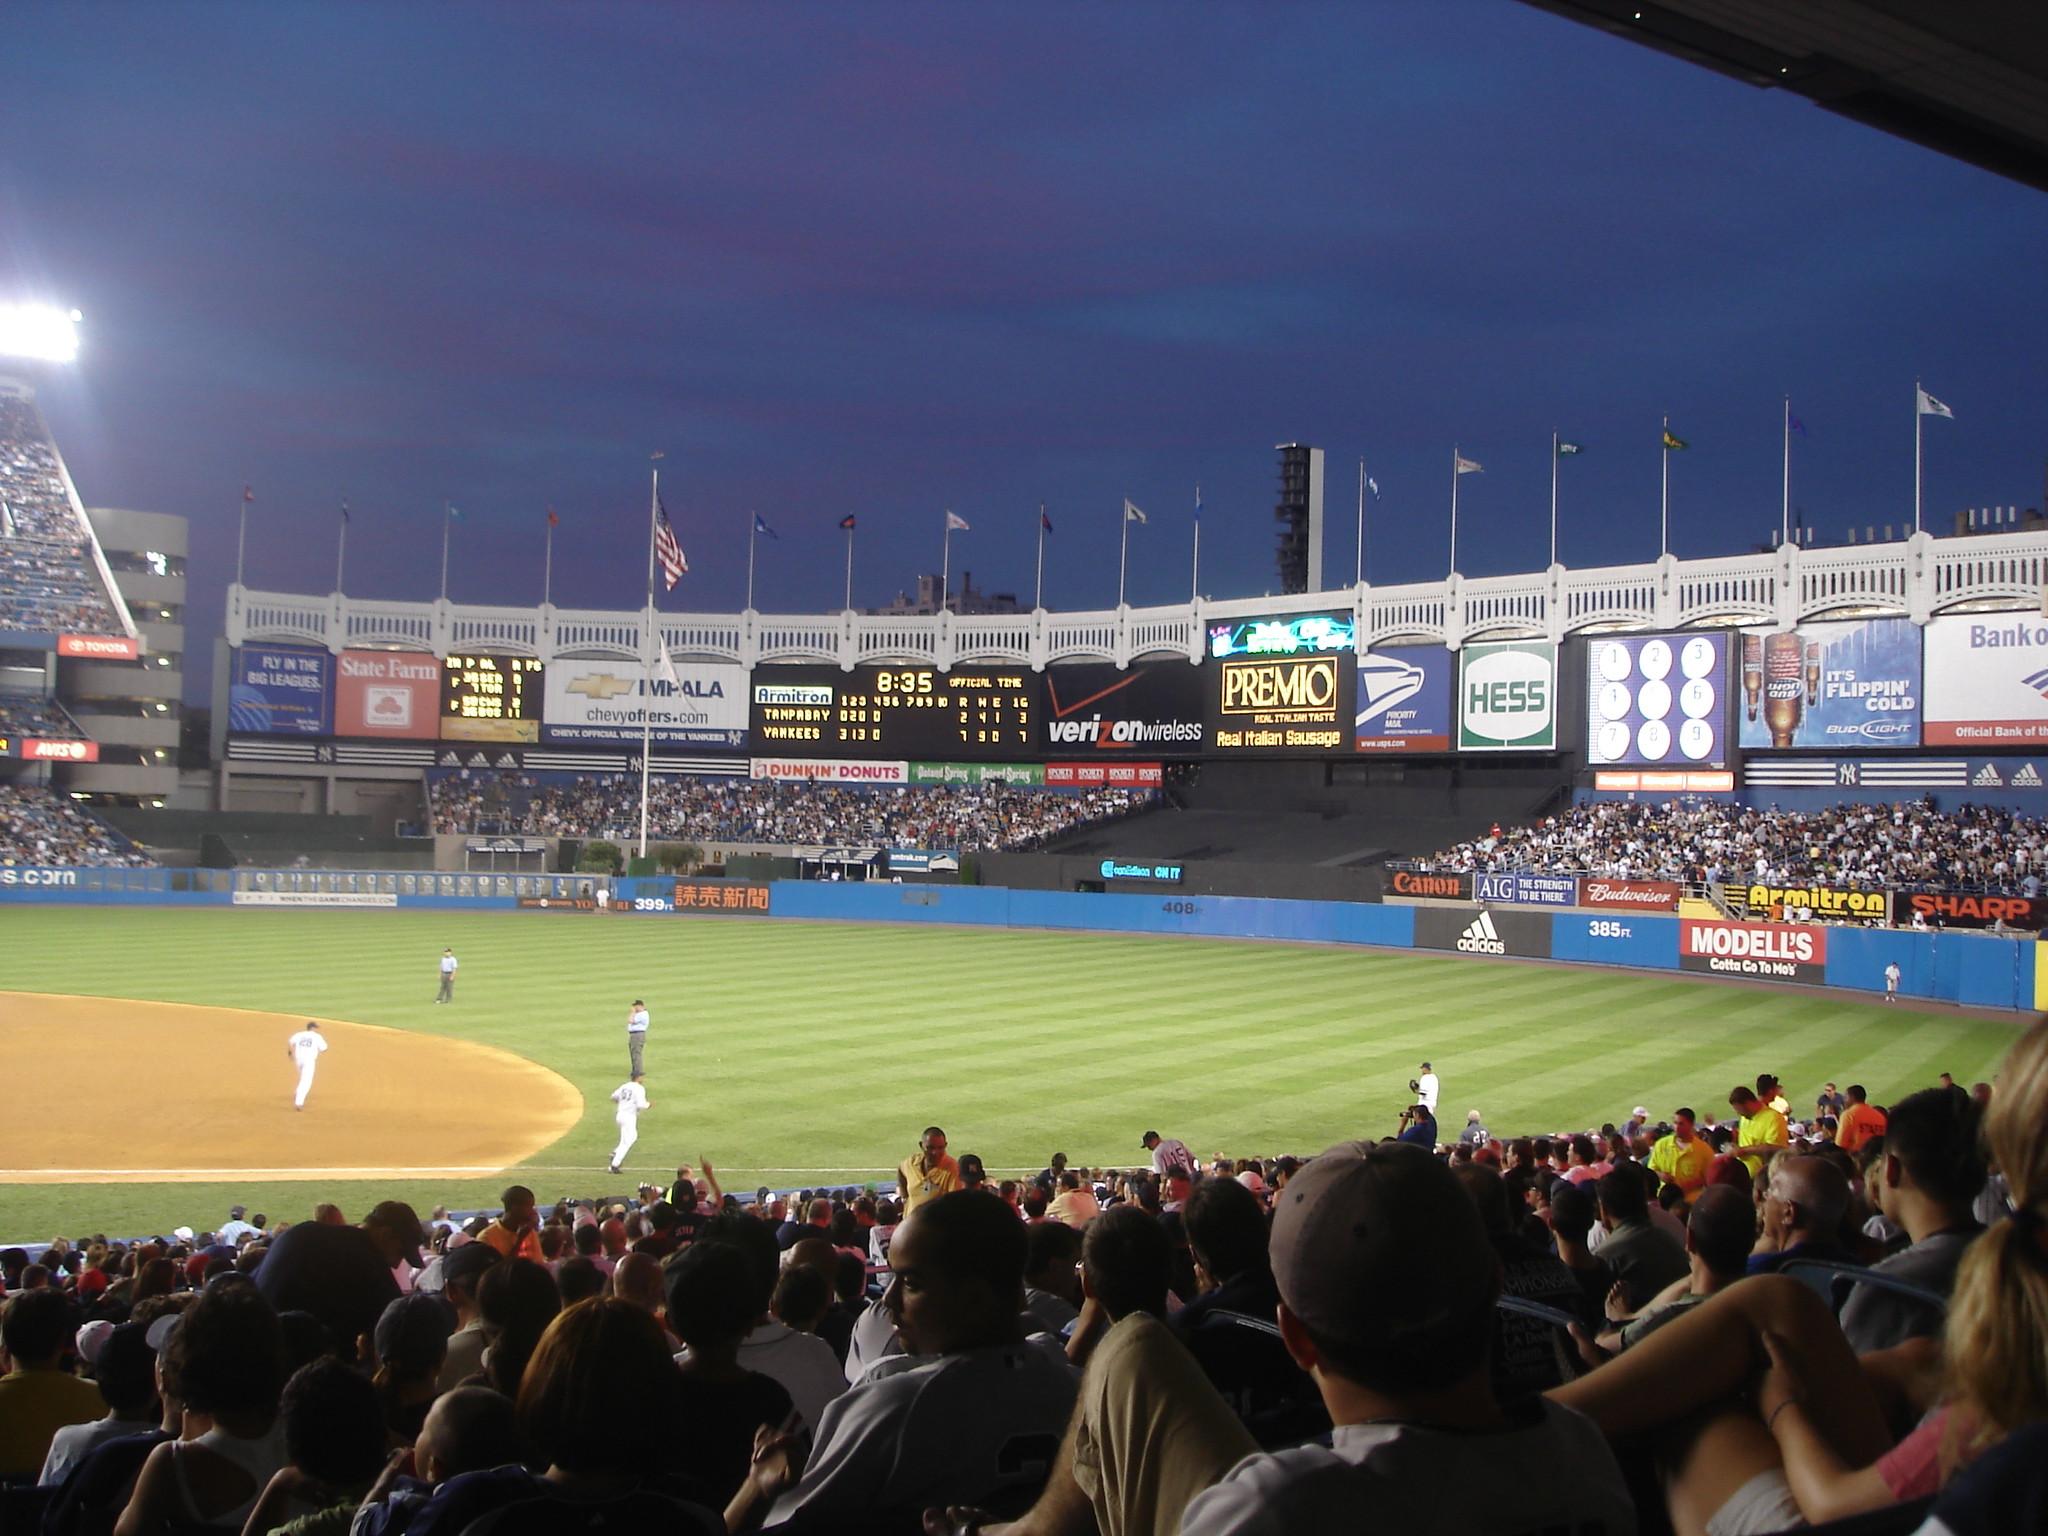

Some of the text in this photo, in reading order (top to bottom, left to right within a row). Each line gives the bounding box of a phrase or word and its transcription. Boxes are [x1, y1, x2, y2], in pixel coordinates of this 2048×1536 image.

[1970, 623, 2031, 649] Bank
[85, 642, 128, 653] TOYOTA
[1694, 643, 1703, 660] 3
[299, 659, 320, 673] THE
[341, 658, 438, 681] State Farm
[248, 671, 268, 685] BIG
[877, 672, 933, 693] 8:35
[949, 677, 1022, 688] OFFICIAL TIME
[1826, 670, 1856, 681] IT'S
[1225, 664, 1334, 707] PREMIO
[1826, 680, 1910, 698] FLIPPIN'
[758, 688, 830, 704] Armitron
[959, 697, 968, 708] R
[993, 697, 1001, 708] E
[1470, 681, 1545, 714] HESS
[1865, 697, 1915, 712] COLD
[1309, 713, 1335, 723] TASTE
[1386, 711, 1417, 719] PRIORITY
[581, 730, 618, 739] OFFICIAL
[656, 732, 667, 740] OF
[670, 732, 686, 740] THE
[687, 733, 726, 742] YANKEES
[763, 727, 821, 740] YANKEES
[1826, 725, 1912, 734] BUD LIGHT
[1956, 726, 1993, 737] Official
[1995, 726, 2022, 737] Bank
[2025, 725, 2036, 736] of
[1216, 730, 1340, 748] Real Italian Sausage
[35, 742, 71, 757] AVIS
[770, 764, 900, 779] DUNKIN' DONUTS
[1393, 871, 1460, 896] Canon
[1479, 878, 1573, 899] AIG THE STRENGTH
[674, 884, 769, 910] 読売新聞
[1519, 890, 1528, 900] TO
[1530, 891, 1540, 901] BE
[1587, 884, 1671, 904] Budweiser
[1750, 886, 1885, 912] Armitron
[1911, 895, 2030, 920] SHARP
[1457, 938, 1505, 954] adidas
[1691, 926, 1813, 961] MODELL'S
[1710, 957, 1796, 976] Gotta Go To Mo's
